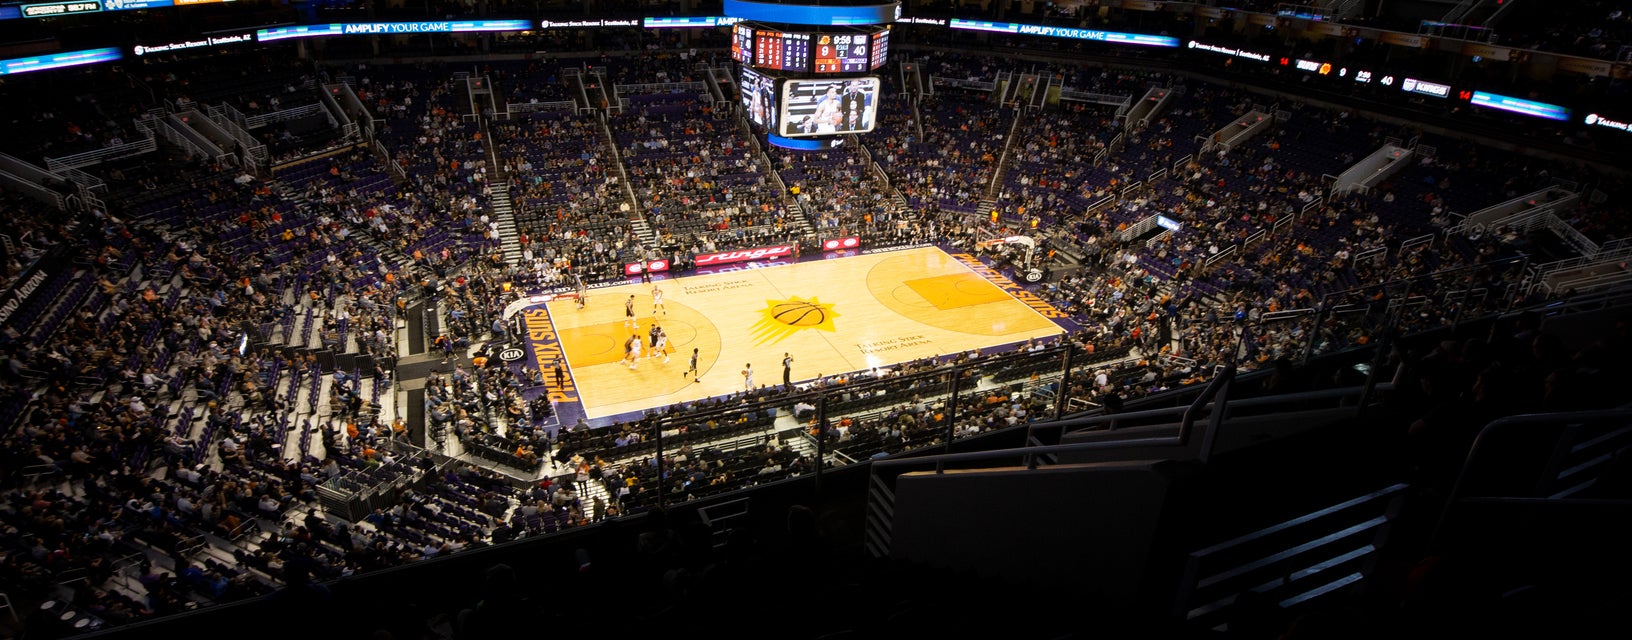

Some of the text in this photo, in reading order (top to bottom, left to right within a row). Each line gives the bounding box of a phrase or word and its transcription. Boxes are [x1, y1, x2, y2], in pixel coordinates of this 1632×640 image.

[346, 22, 449, 33] AMPLIFY YOUR GAME
[1020, 24, 1104, 40] AMPLIFY YOUR GAME
[822, 46, 829, 56] 9
[853, 46, 865, 56] 40
[1340, 68, 1346, 76] 9
[1380, 76, 1394, 86] 40
[1459, 91, 1471, 100] 14
[14, 269, 48, 304] ARIZONA
[951, 253, 1069, 318] PHOENIX SUNS
[524, 308, 556, 340] SUNS
[532, 341, 578, 402] PHOENIX
